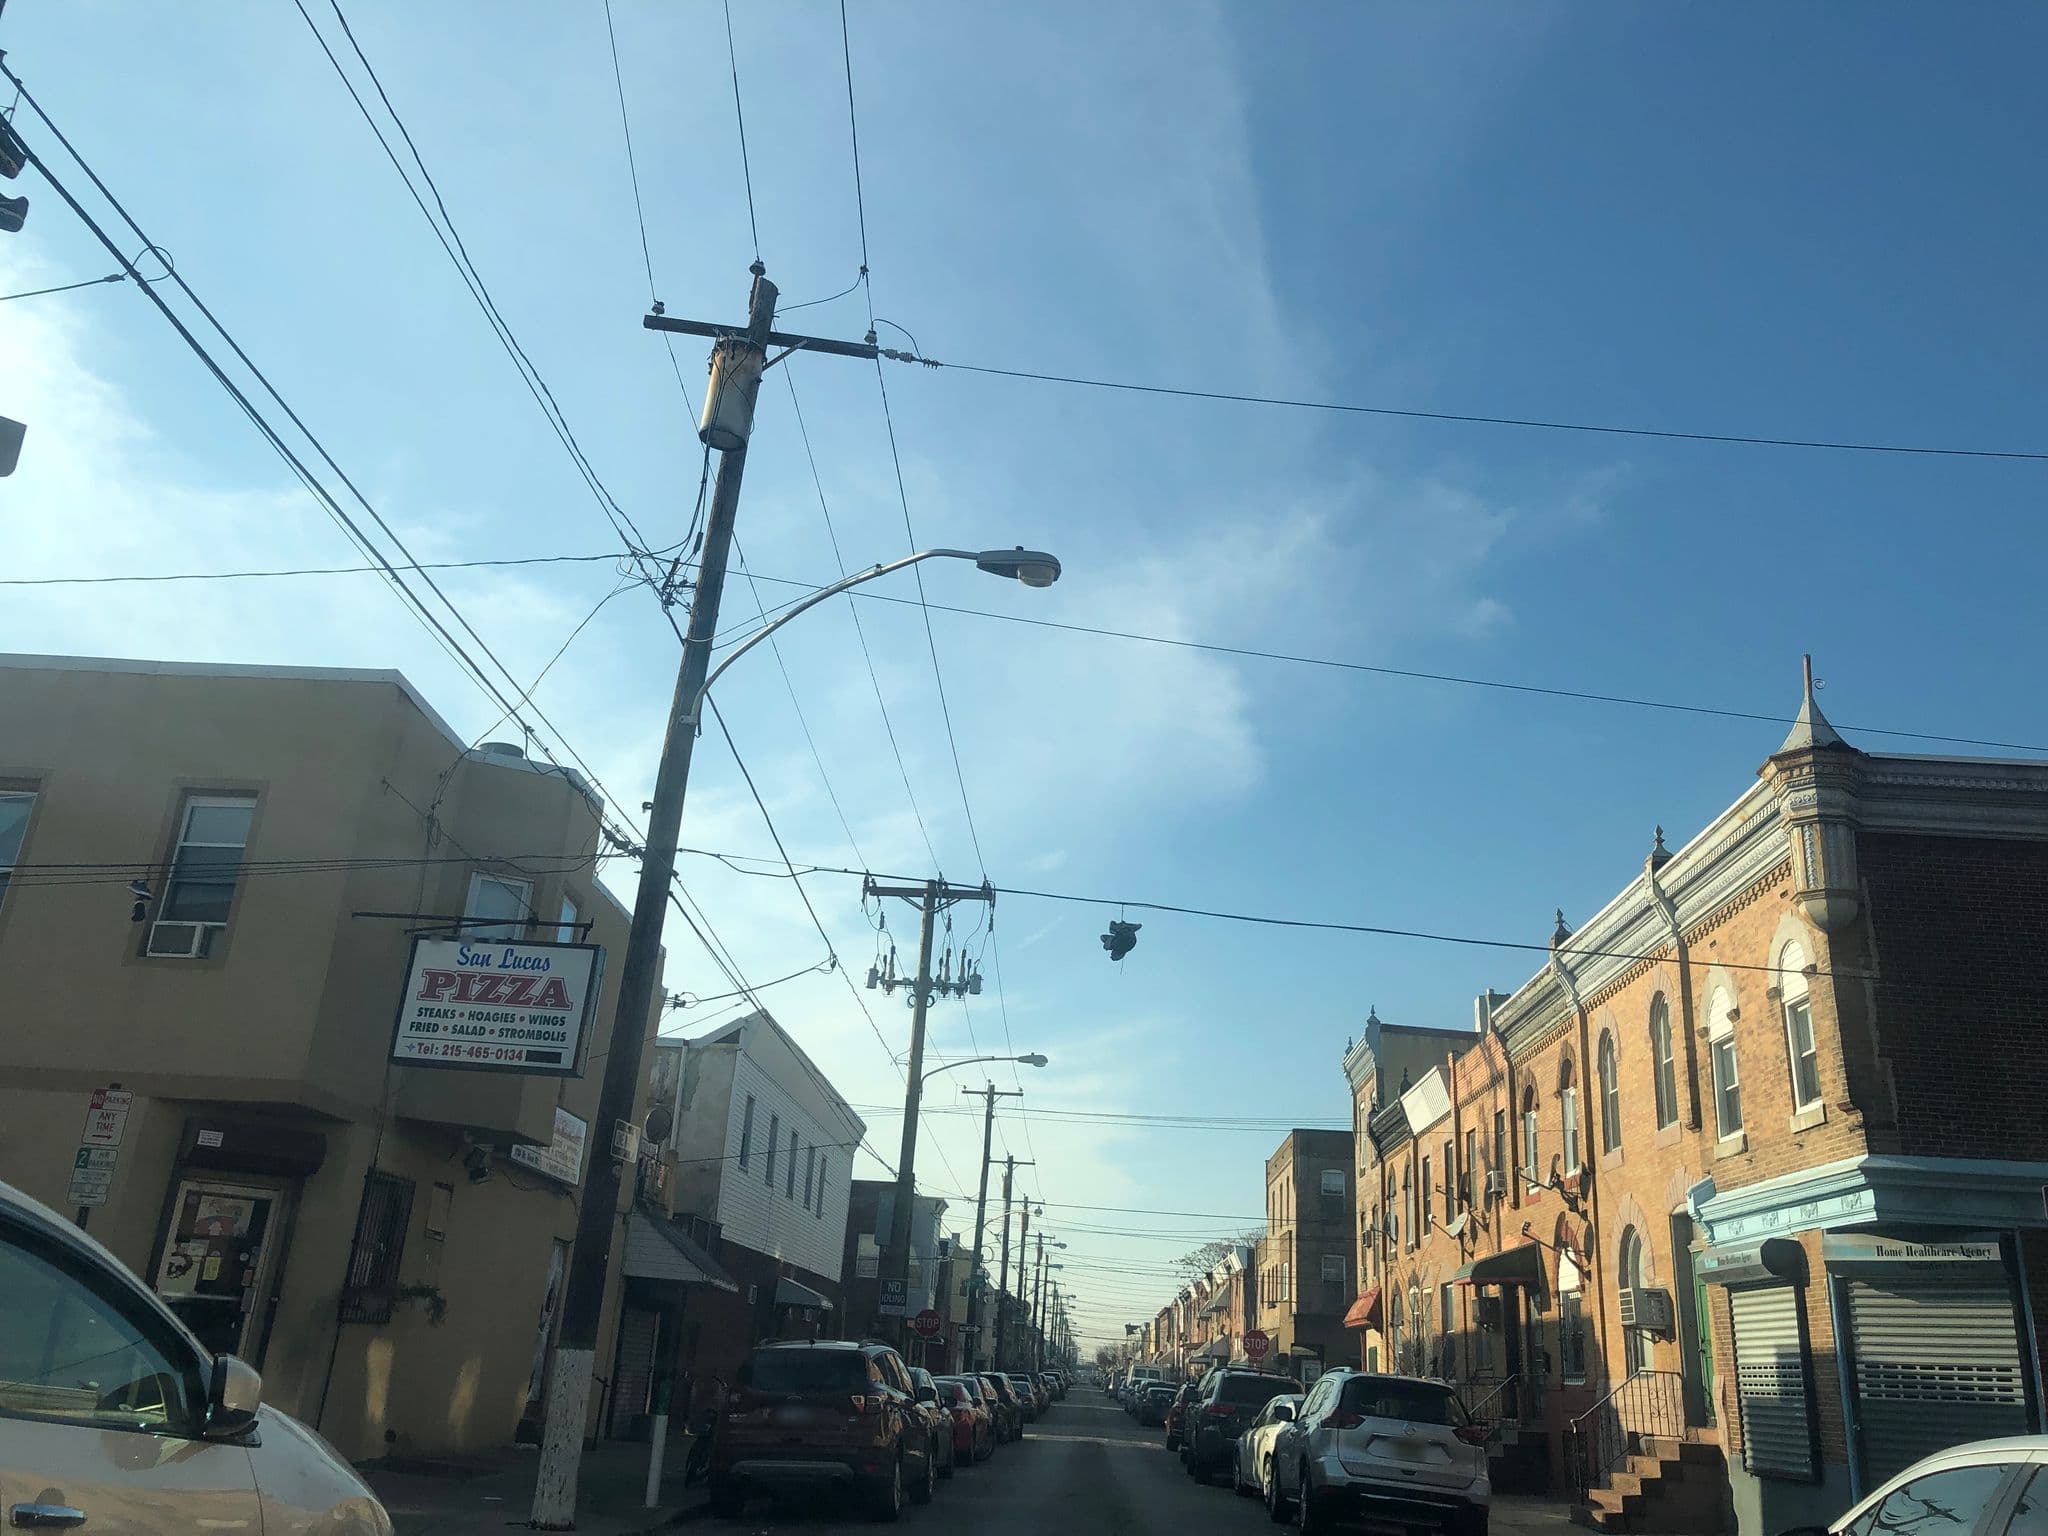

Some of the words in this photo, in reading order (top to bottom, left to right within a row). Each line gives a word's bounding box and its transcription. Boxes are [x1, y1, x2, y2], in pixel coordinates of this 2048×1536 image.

[457, 946, 492, 967] San
[497, 948, 551, 971] Lucas
[416, 968, 573, 1011] PIZZA
[416, 1006, 456, 1020] STEAKS
[467, 1009, 517, 1024] HOAGIES
[528, 1014, 566, 1027] WINGS
[409, 1021, 440, 1033] FRIED
[450, 1024, 486, 1037] SALAD
[497, 1028, 567, 1042] STROMBOLIS
[417, 1042, 440, 1056] Tel:
[441, 1044, 523, 1061] 215-465-0134
[98, 1111, 117, 1121] ANY
[96, 1122, 115, 1132] TIME
[77, 1151, 88, 1167] 2
[1876, 1245, 1903, 1257] Home
[1906, 1244, 1955, 1257] Healthcare
[1959, 1244, 1992, 1259] Agency
[888, 1281, 901, 1293] NO
[881, 1293, 905, 1304] IDLING
[917, 1317, 939, 1329] STOP
[1245, 1338, 1267, 1349] STOP
